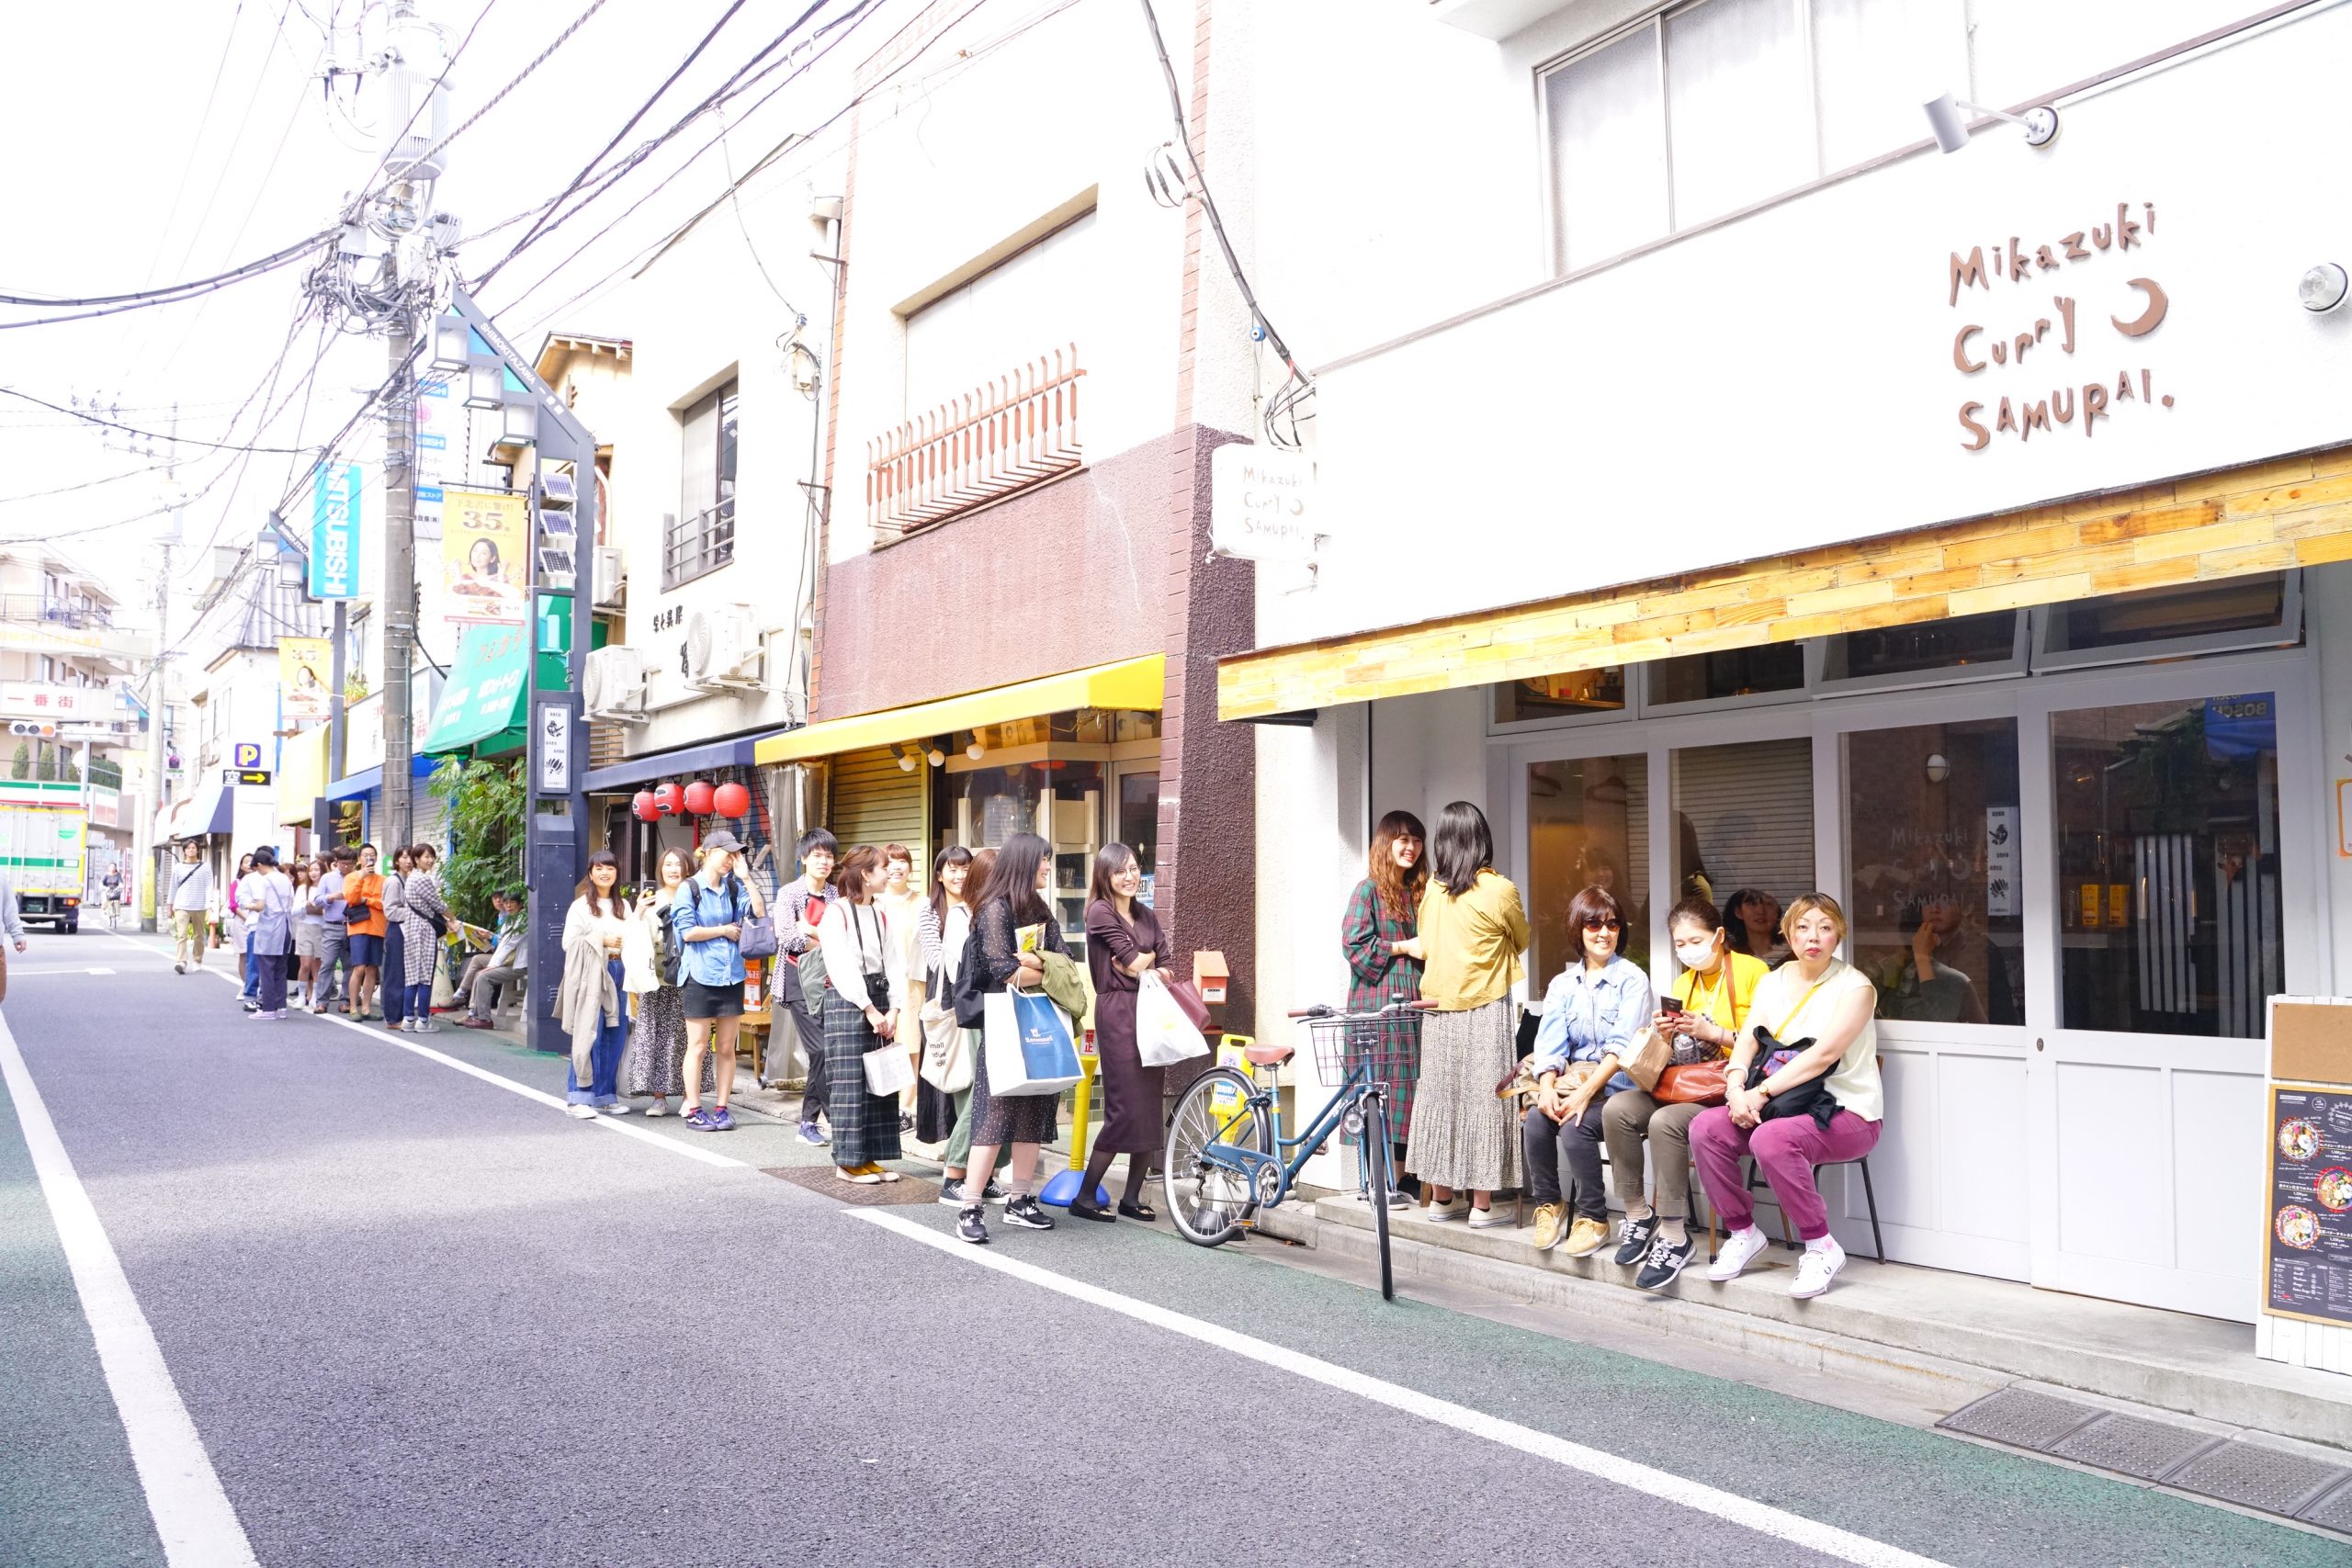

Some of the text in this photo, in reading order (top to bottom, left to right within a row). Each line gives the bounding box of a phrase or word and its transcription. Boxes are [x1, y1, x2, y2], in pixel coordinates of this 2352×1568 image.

[1949, 202, 2155, 307] Mikazuki
[480, 322, 537, 385] SHIMOKITAZAWA
[1953, 296, 2075, 373] Curry
[1958, 368, 2175, 450] SAMURAI.
[1243, 465, 1302, 488] Mikazuki
[324, 462, 350, 595] MITSUBISHI
[7, 693, 74, 709] 一番街
[238, 745, 258, 766] P
